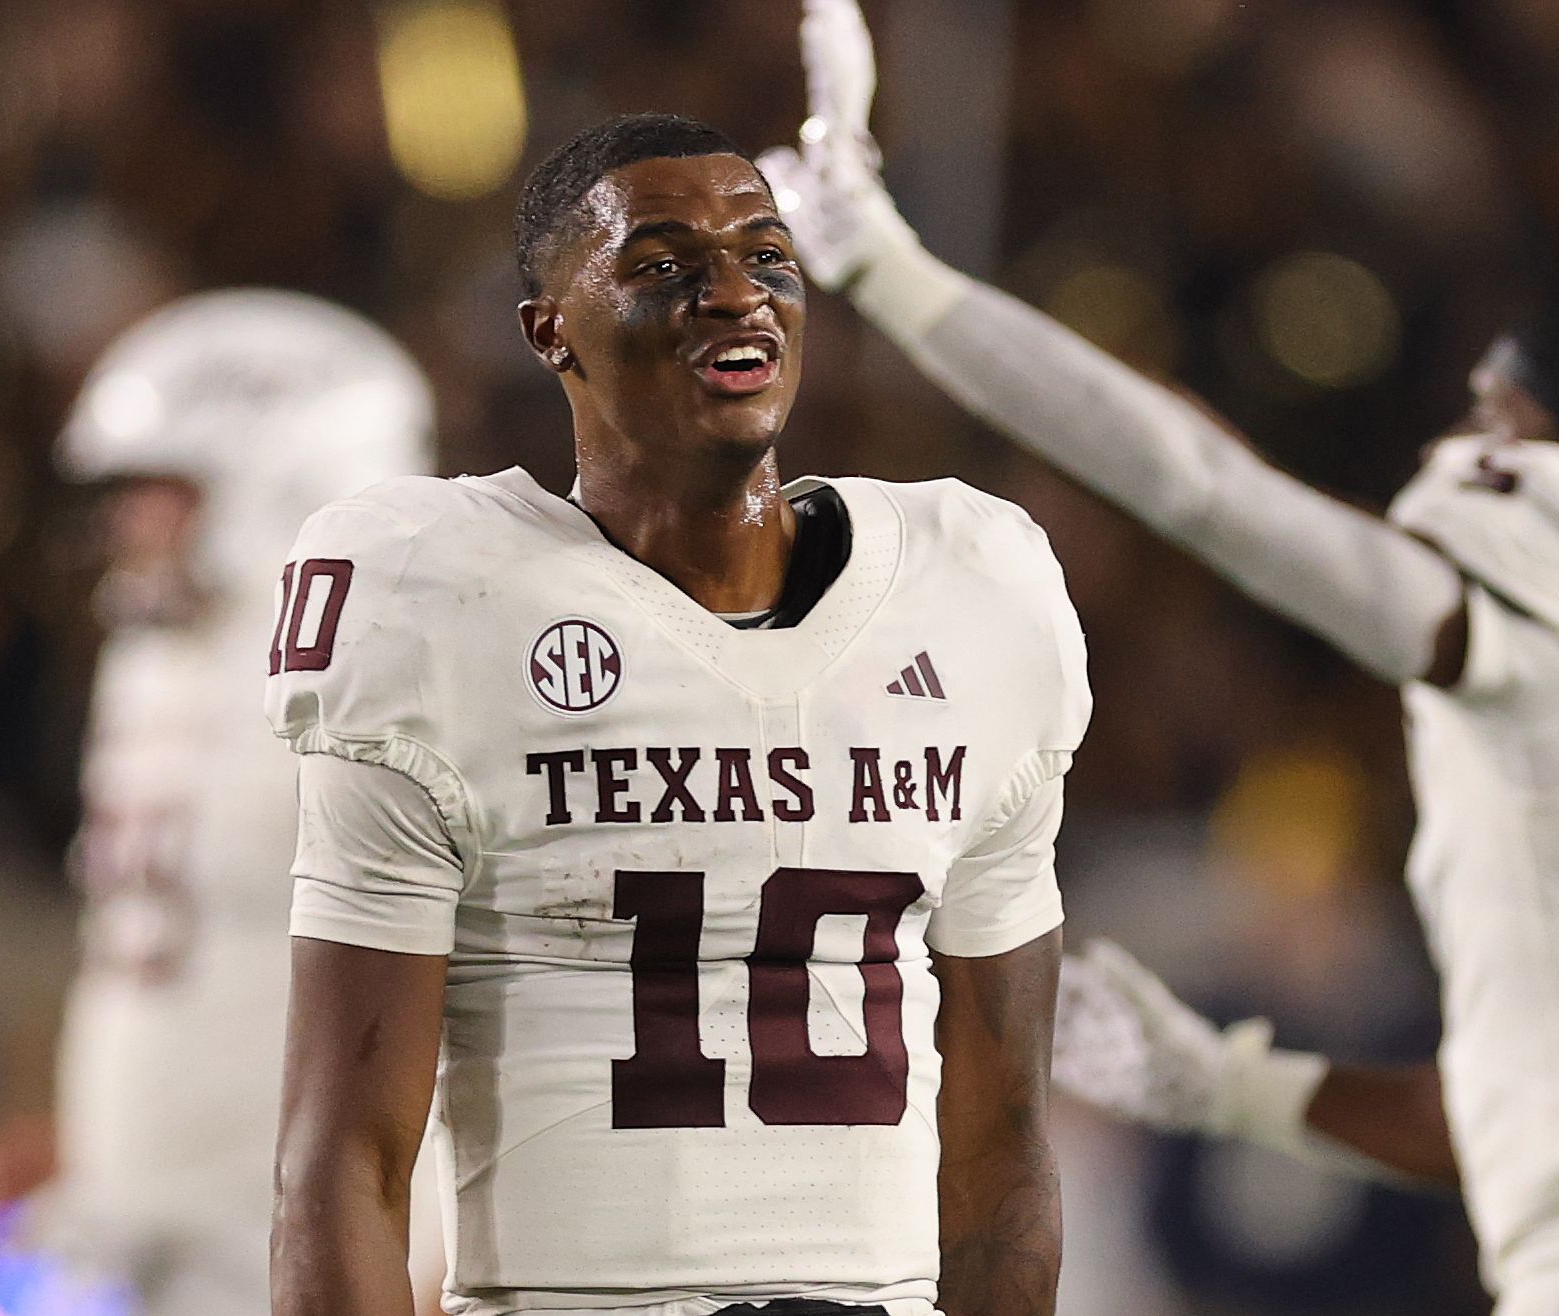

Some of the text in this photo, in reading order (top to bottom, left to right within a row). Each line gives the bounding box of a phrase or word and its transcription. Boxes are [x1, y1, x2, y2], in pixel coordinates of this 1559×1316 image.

[269, 558, 355, 676] 10
[533, 623, 617, 708] SEC
[526, 745, 967, 827] TEXAS A&M
[611, 866, 926, 1130] 10
